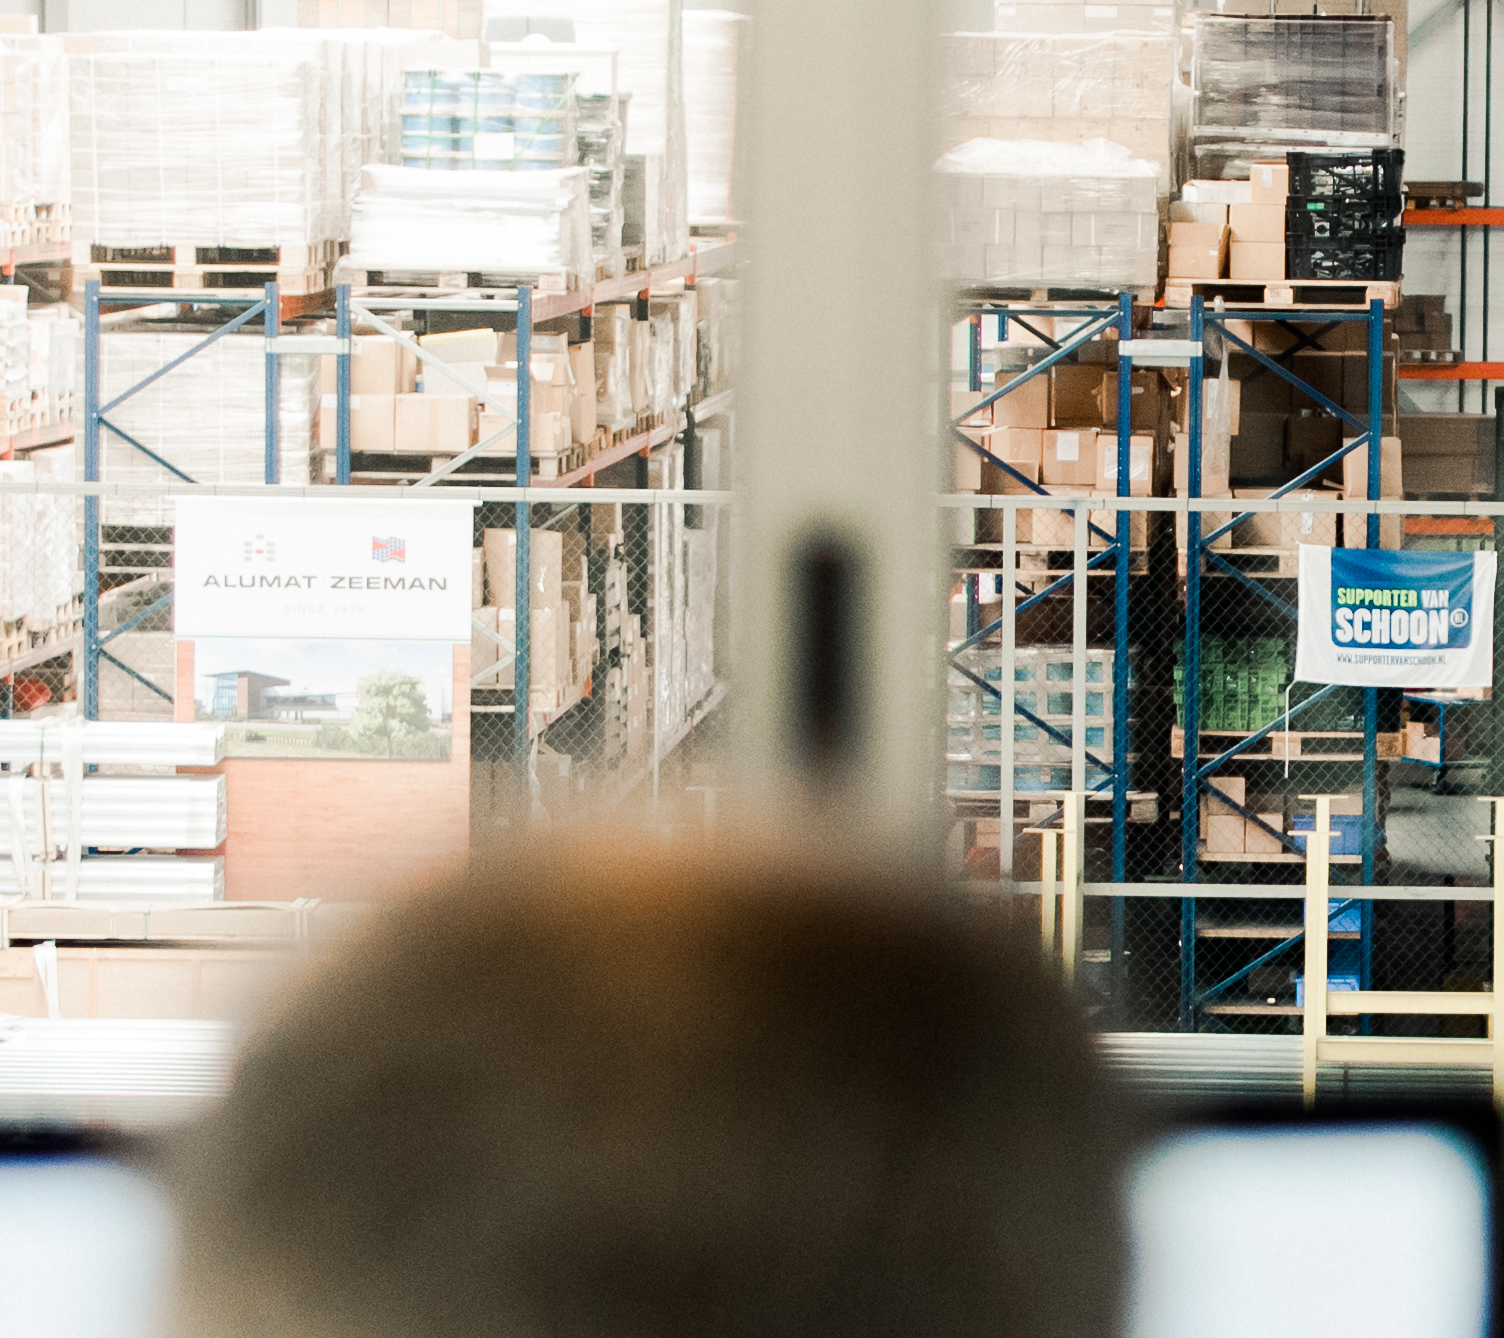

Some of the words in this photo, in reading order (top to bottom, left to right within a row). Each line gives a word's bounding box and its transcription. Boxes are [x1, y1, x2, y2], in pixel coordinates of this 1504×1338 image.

[203, 574, 318, 589] ALUMAT
[330, 575, 448, 591] ZEEMAN
[1337, 587, 1418, 607] SUPPORTER
[1421, 589, 1450, 607] VAN
[283, 604, 325, 614] SINCE
[1335, 607, 1450, 645] SCHOON
